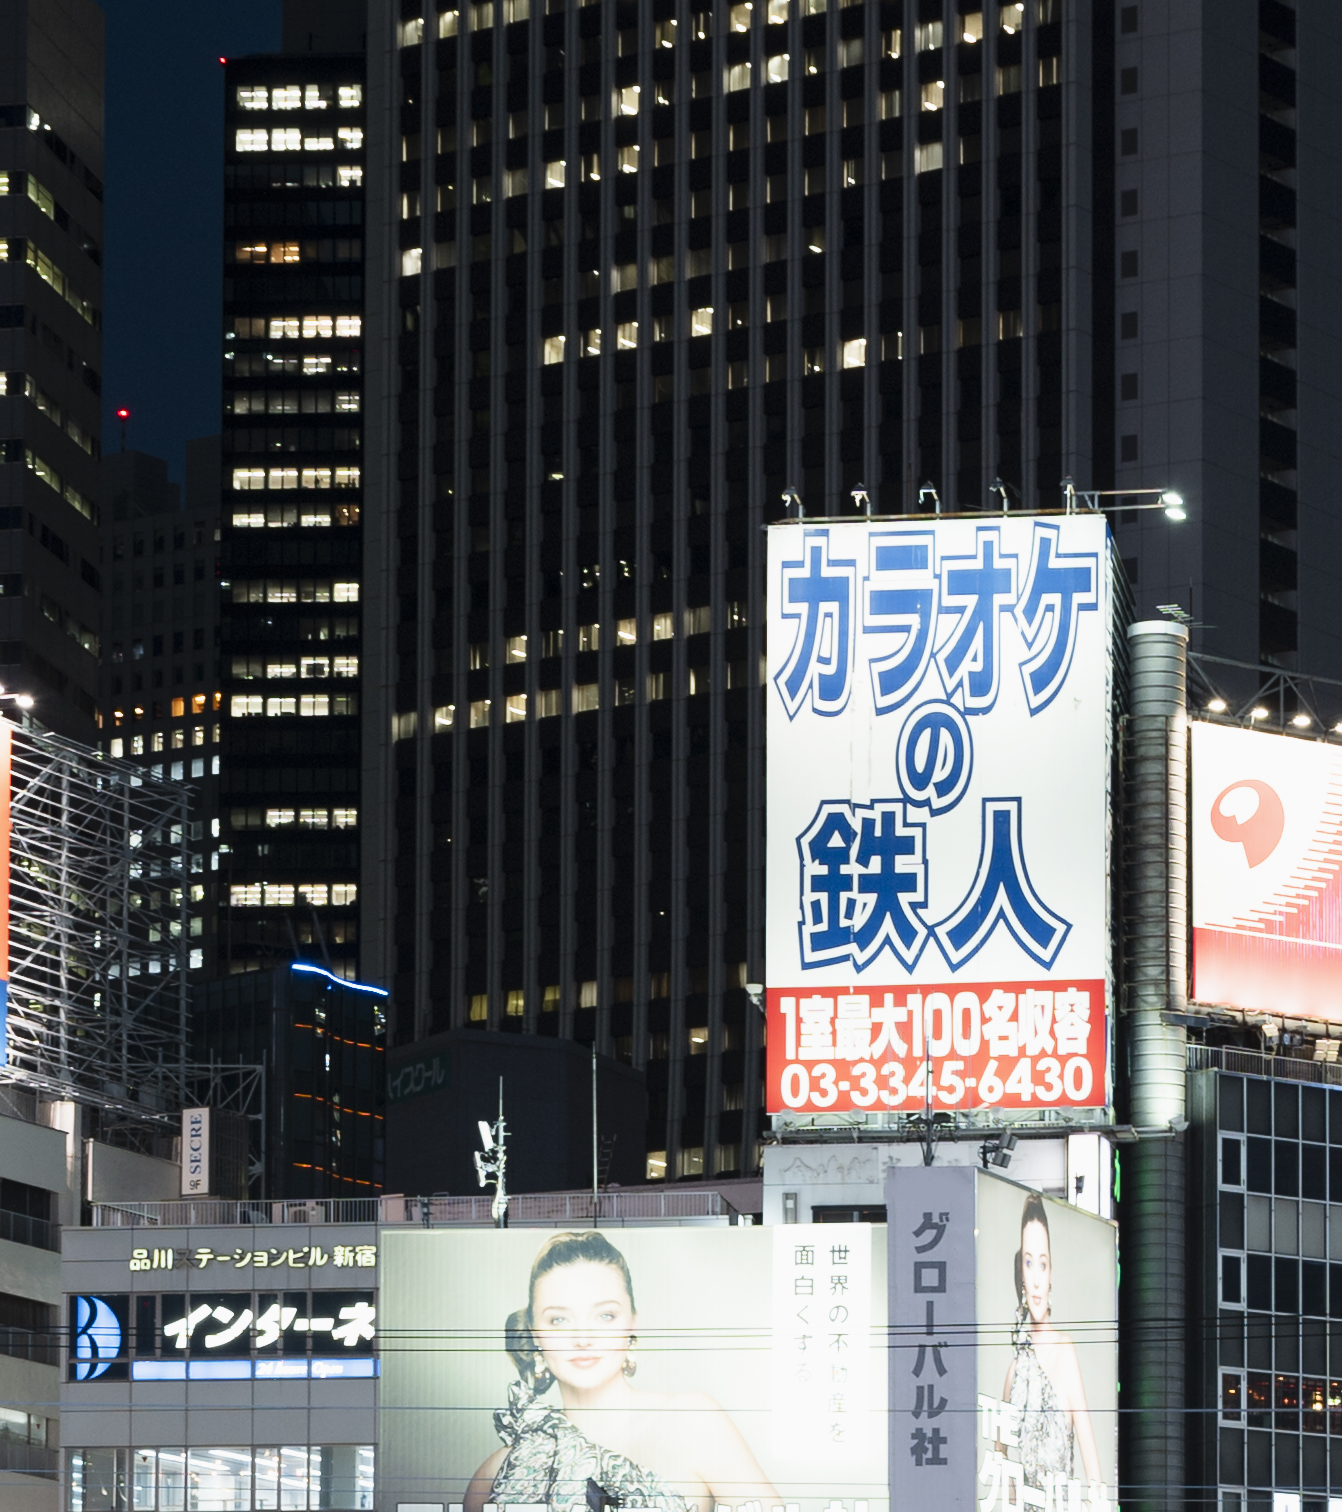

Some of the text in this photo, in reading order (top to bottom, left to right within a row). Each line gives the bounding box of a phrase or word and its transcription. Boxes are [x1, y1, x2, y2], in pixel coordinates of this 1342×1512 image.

[773, 521, 1099, 721] カラオケ
[896, 697, 974, 816] の
[795, 797, 1073, 974] 鉄人
[780, 987, 1091, 1061] 1室最大100名収容
[780, 1057, 1093, 1109] 03-3345-6430
[129, 1245, 377, 1272] 品川ステーションビル 新宿
[910, 1210, 950, 1468] グローバル社
